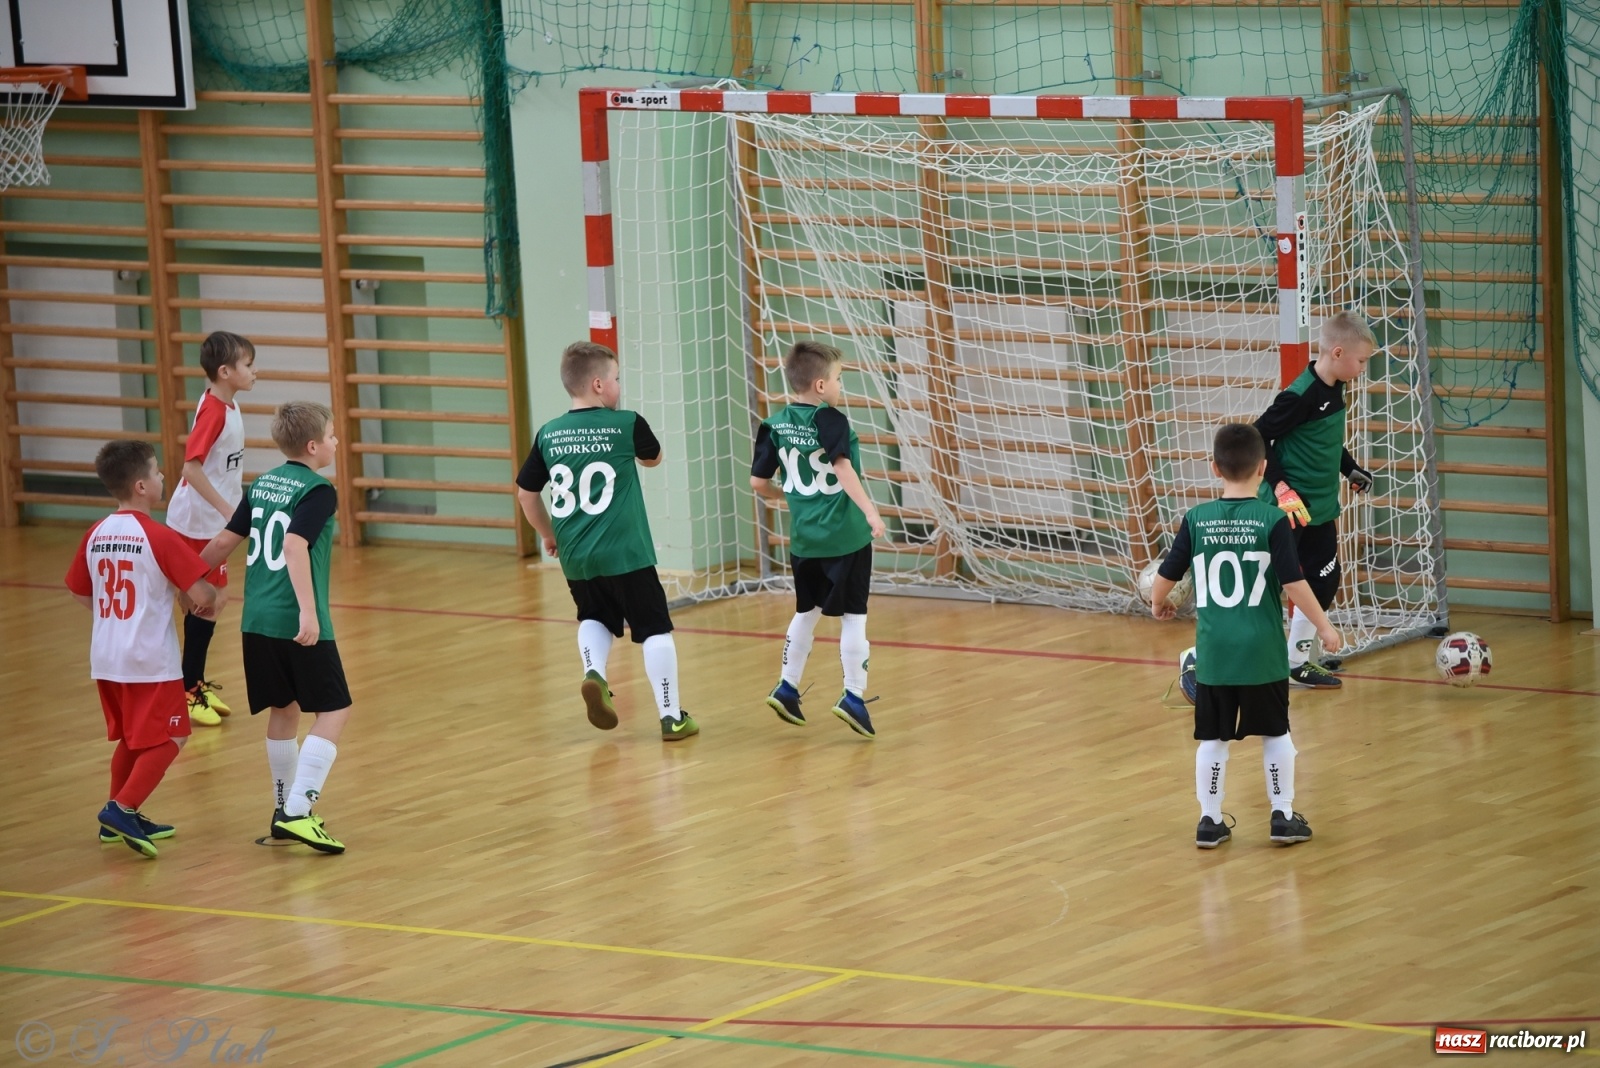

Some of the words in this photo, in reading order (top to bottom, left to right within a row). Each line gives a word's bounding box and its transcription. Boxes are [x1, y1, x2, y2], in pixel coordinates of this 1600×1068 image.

[641, 95, 668, 106] sport
[543, 428, 576, 439] AKADEMIA
[577, 427, 622, 436] PIŁKARSKA
[548, 441, 614, 457] TWORKÓW
[551, 435, 586, 445] MŁODEGO
[778, 446, 844, 496] 108
[549, 461, 617, 518] 80
[246, 507, 292, 571] 50
[1201, 533, 1258, 546] TWORKÓW
[98, 558, 136, 621] 35
[1192, 550, 1271, 609] 107
